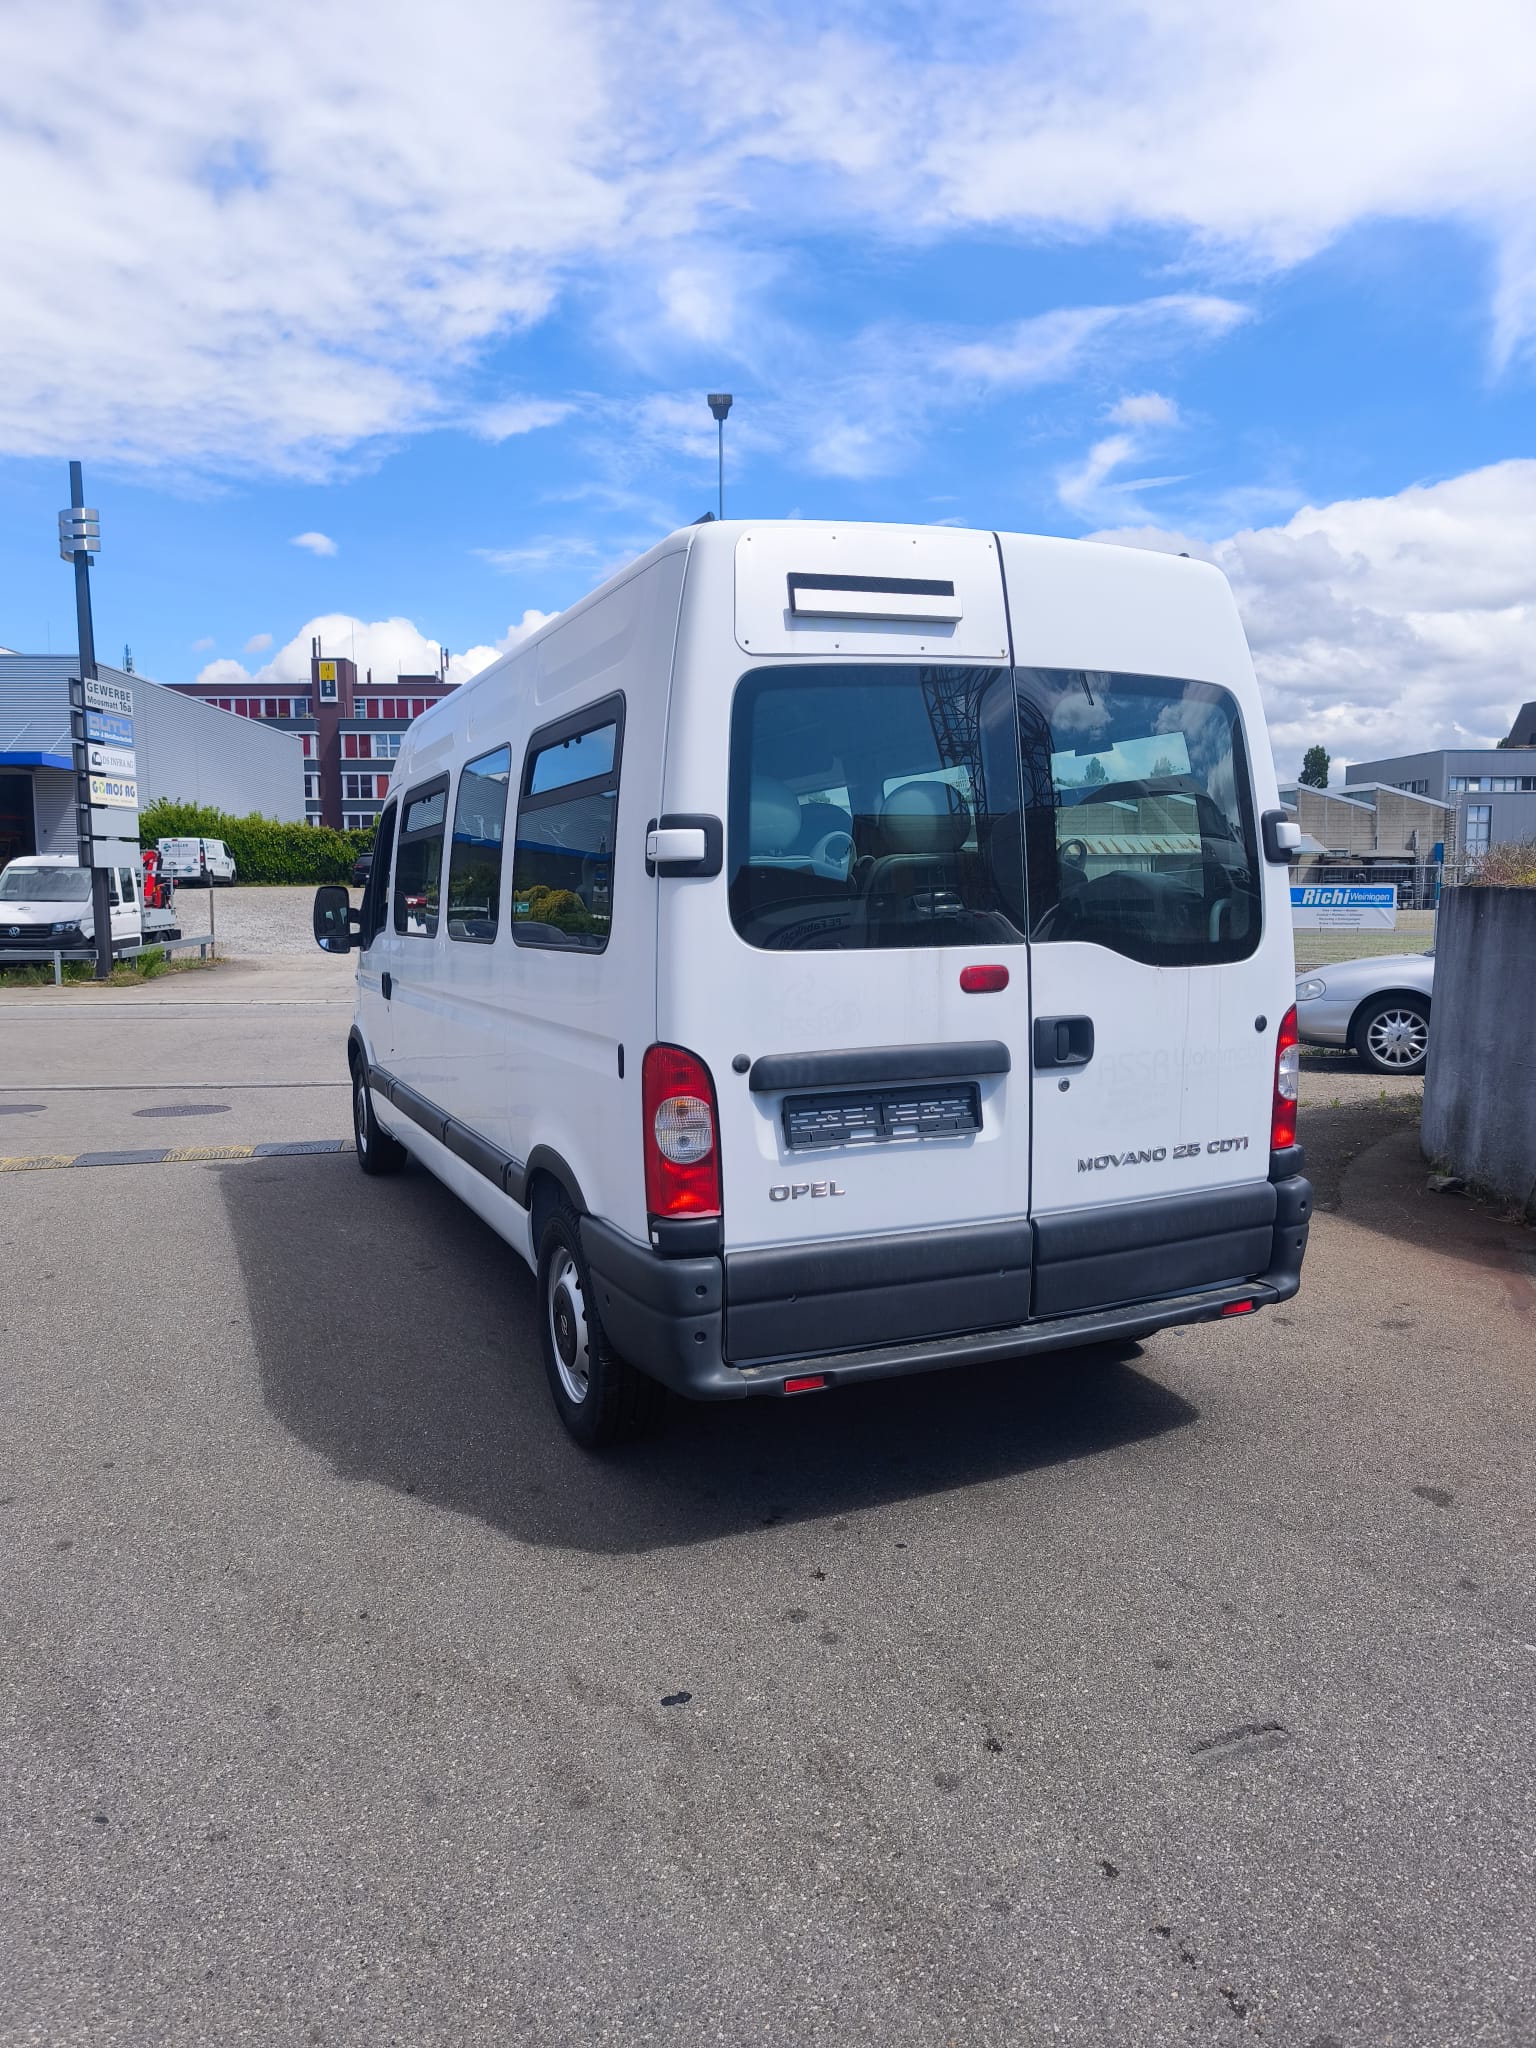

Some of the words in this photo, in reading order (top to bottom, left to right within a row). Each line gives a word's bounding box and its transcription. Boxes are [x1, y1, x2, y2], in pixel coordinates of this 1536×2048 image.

[86, 682, 131, 702] GEWERBE
[87, 695, 118, 710] Moosmatt
[119, 701, 132, 713] 16a
[125, 784, 136, 798] AG
[1302, 889, 1351, 905] Richi
[1350, 892, 1390, 902] Weiningen
[1077, 1147, 1167, 1173] MOVANO
[769, 1180, 846, 1202] OPEL
